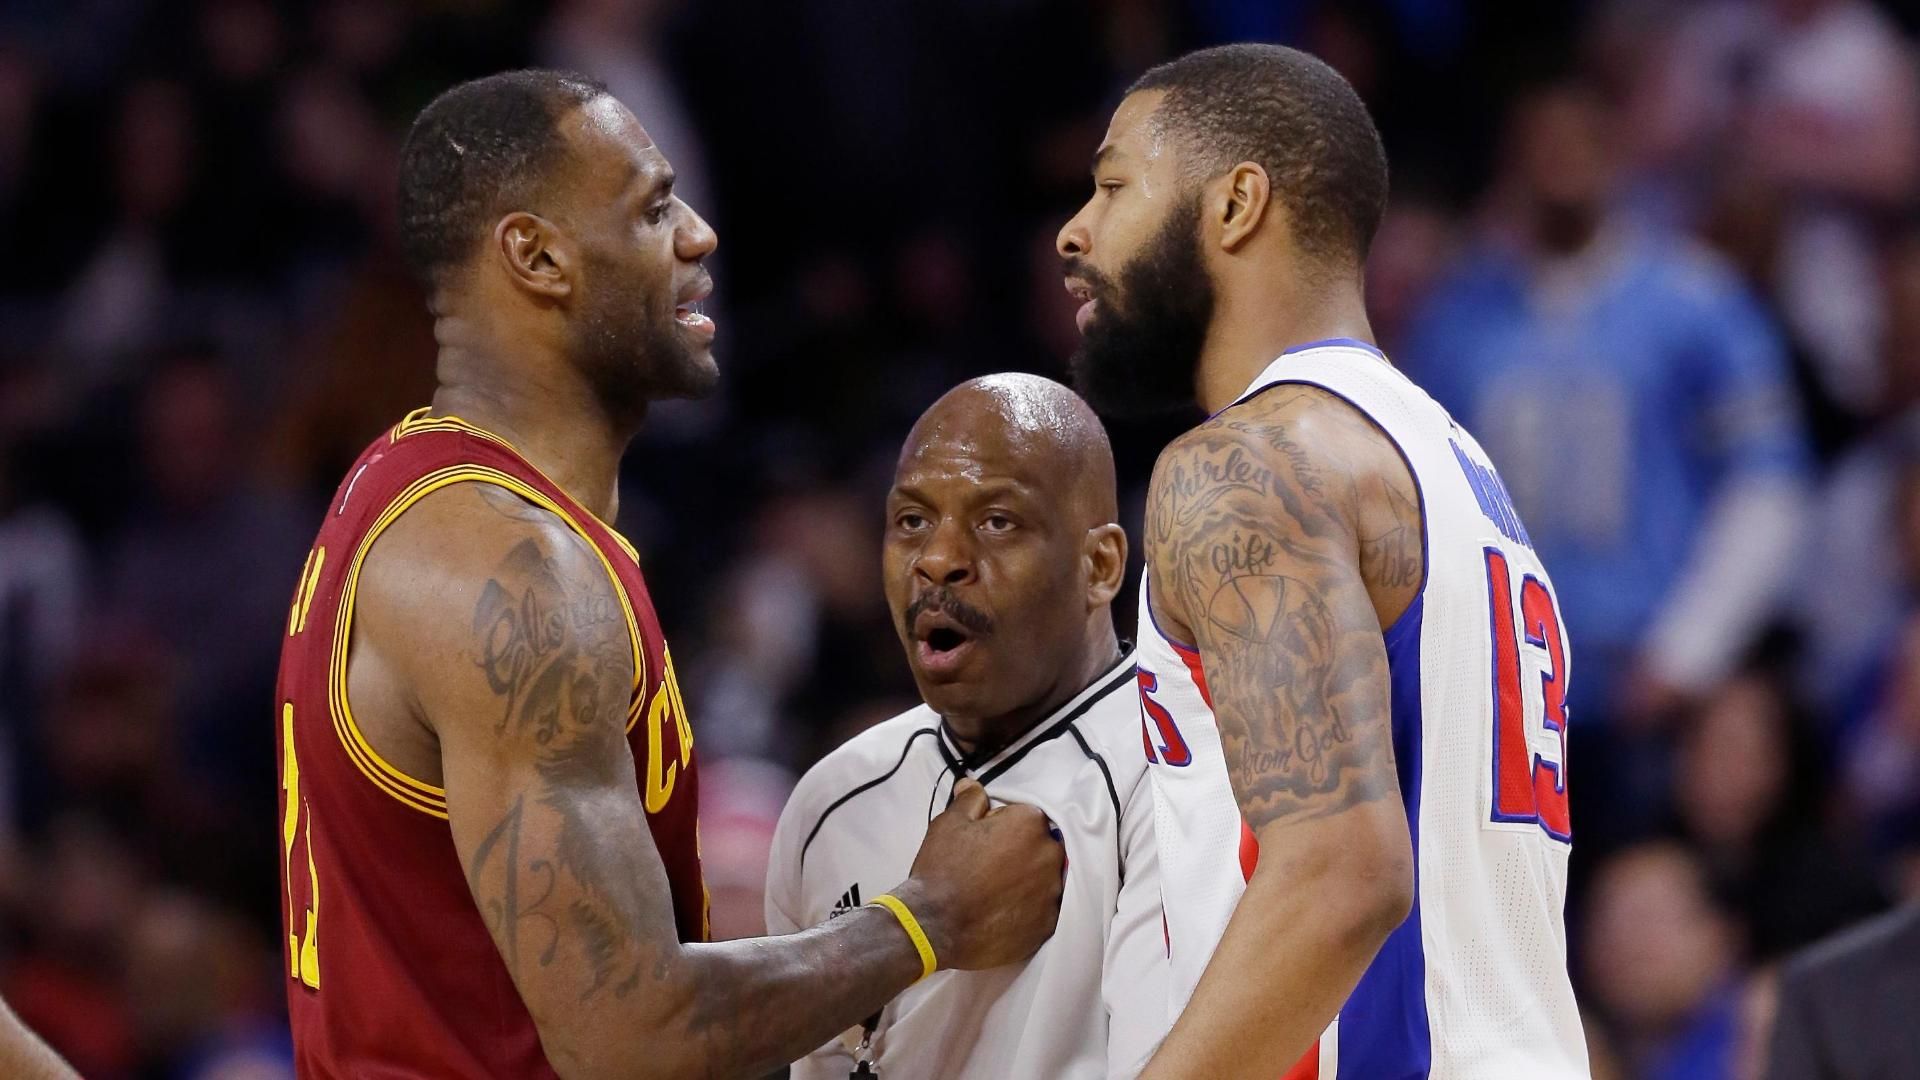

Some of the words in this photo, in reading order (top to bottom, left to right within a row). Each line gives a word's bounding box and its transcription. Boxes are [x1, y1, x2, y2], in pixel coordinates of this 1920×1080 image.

[1211, 533, 1279, 588] gift
[1483, 546, 1572, 845] 13
[1240, 738, 1293, 787] from
[1296, 704, 1353, 784] God
